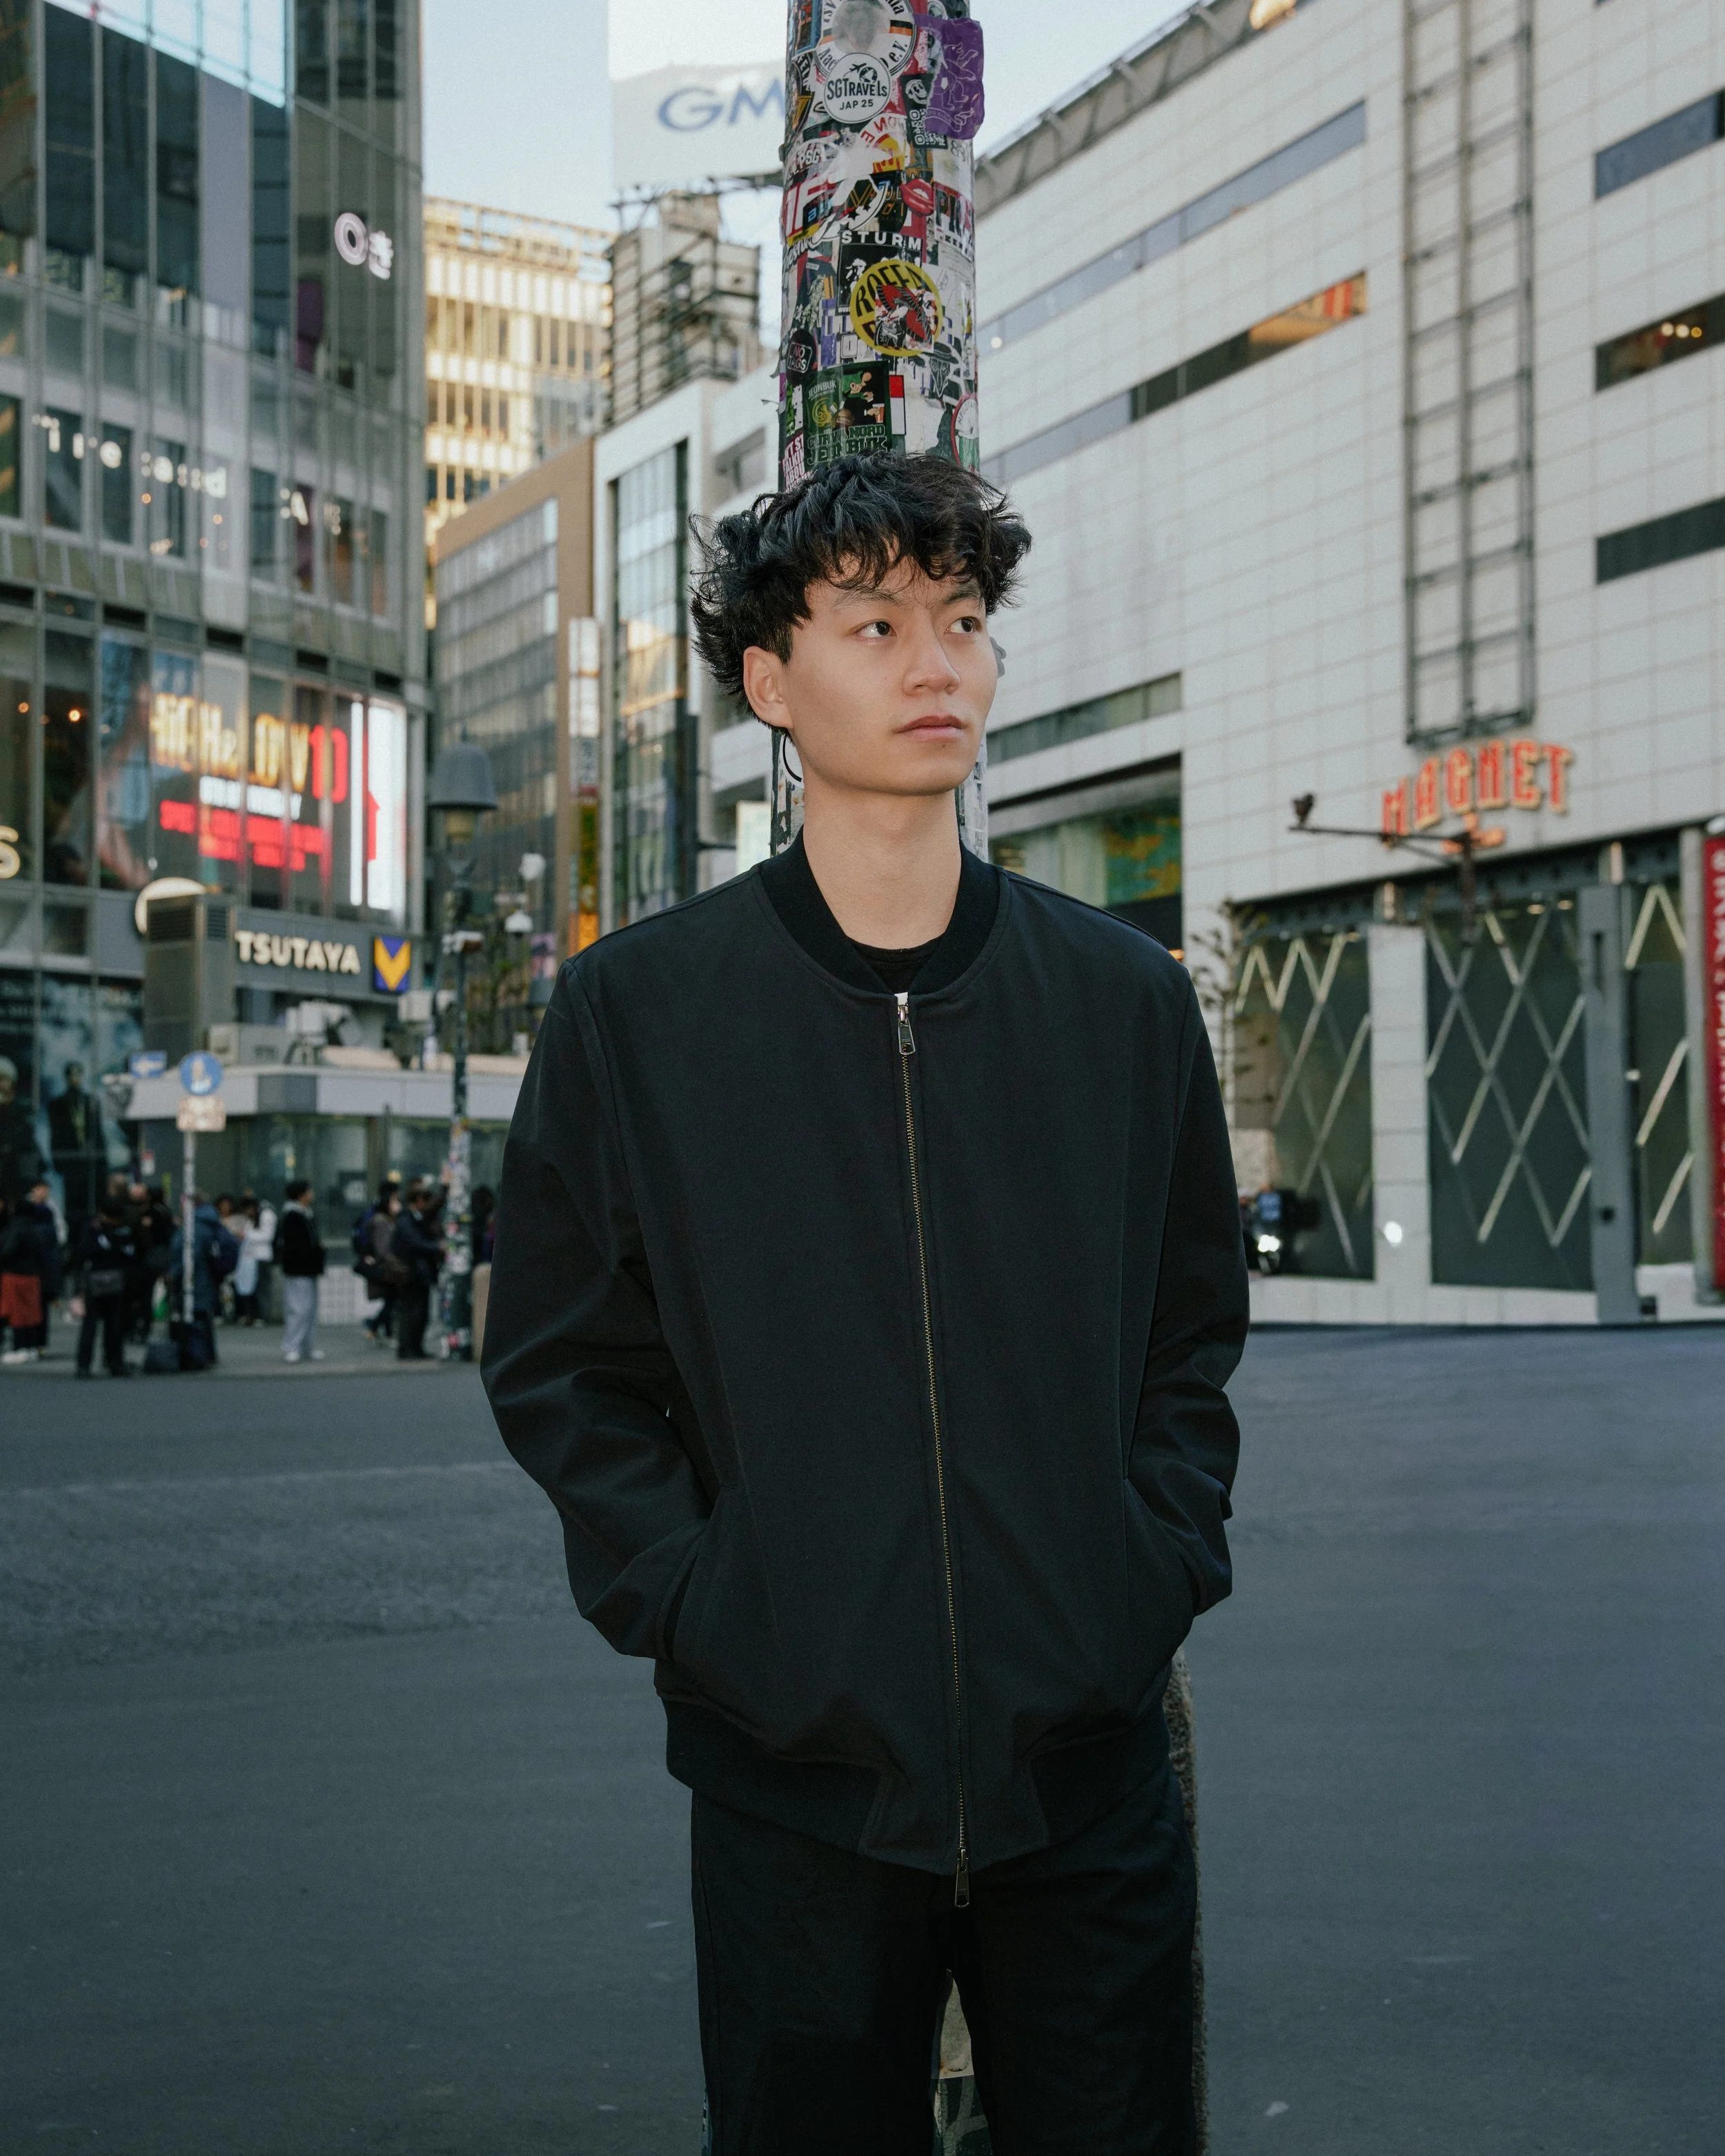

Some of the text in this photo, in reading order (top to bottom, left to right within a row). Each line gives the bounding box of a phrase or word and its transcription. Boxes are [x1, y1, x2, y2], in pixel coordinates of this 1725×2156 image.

[839, 99, 874, 110] JAP 25
[841, 230, 922, 250] STURM
[795, 345, 805, 358] NO
[789, 355, 807, 370] TAGS
[808, 380, 837, 400] JEONBUK
[1382, 738, 1574, 837] MAGNET
[235, 931, 361, 974] TSUTAYA
